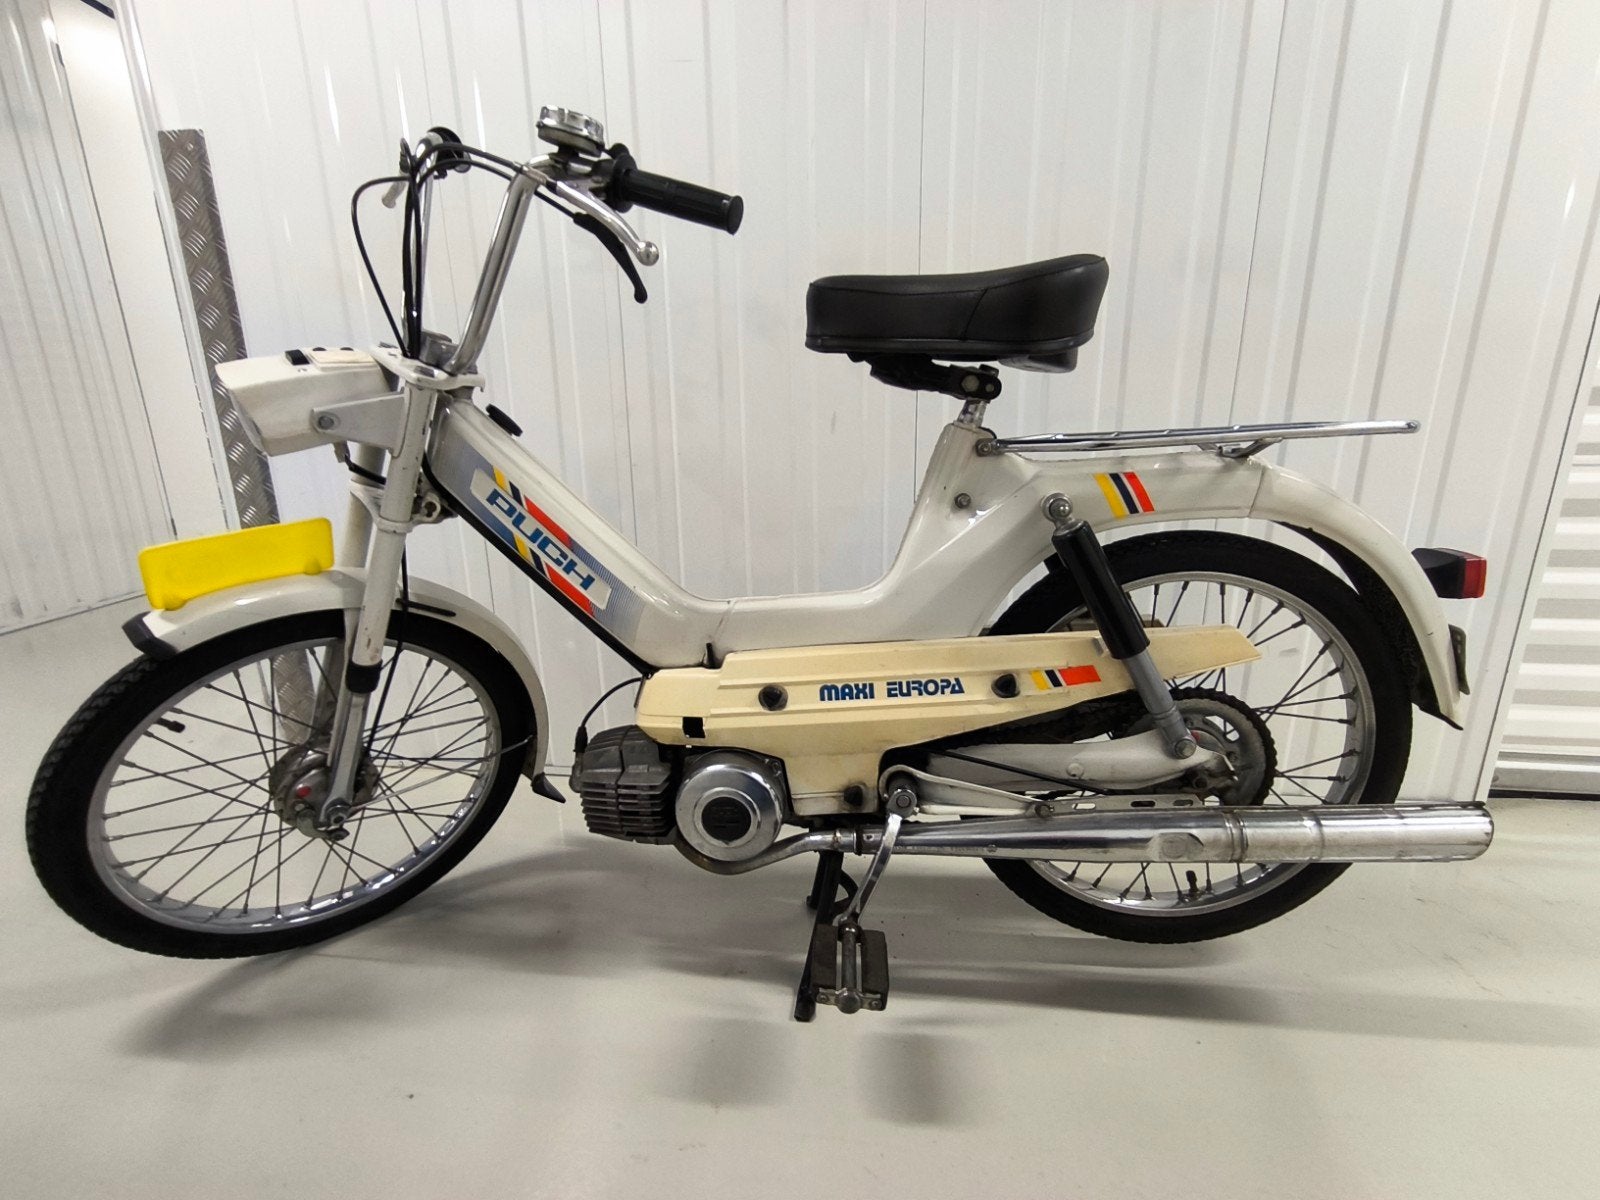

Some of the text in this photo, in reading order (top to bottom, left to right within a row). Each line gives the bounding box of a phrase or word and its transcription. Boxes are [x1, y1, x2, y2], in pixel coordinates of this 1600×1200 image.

[486, 488, 596, 591] PUCH
[819, 677, 965, 702] MAXI EUROPA
